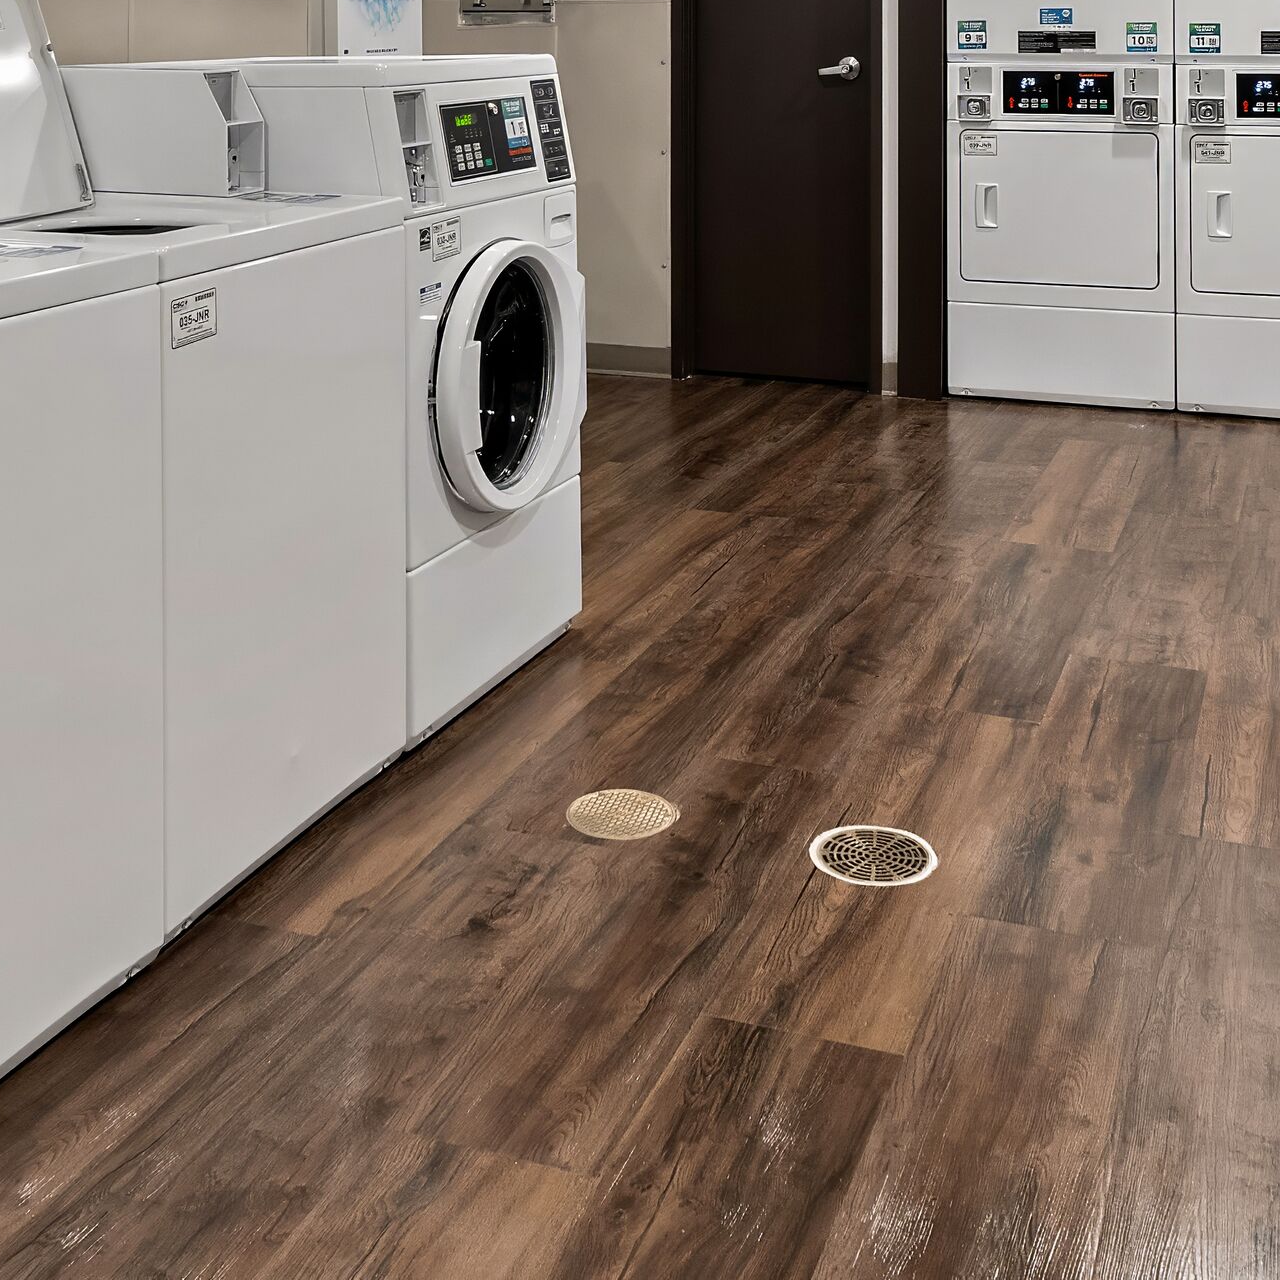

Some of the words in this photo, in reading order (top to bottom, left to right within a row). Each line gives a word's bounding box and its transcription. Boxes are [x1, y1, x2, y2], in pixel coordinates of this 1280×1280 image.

[965, 33, 972, 42] 9
[1132, 36, 1145, 45] 10
[1196, 37, 1205, 46] 11
